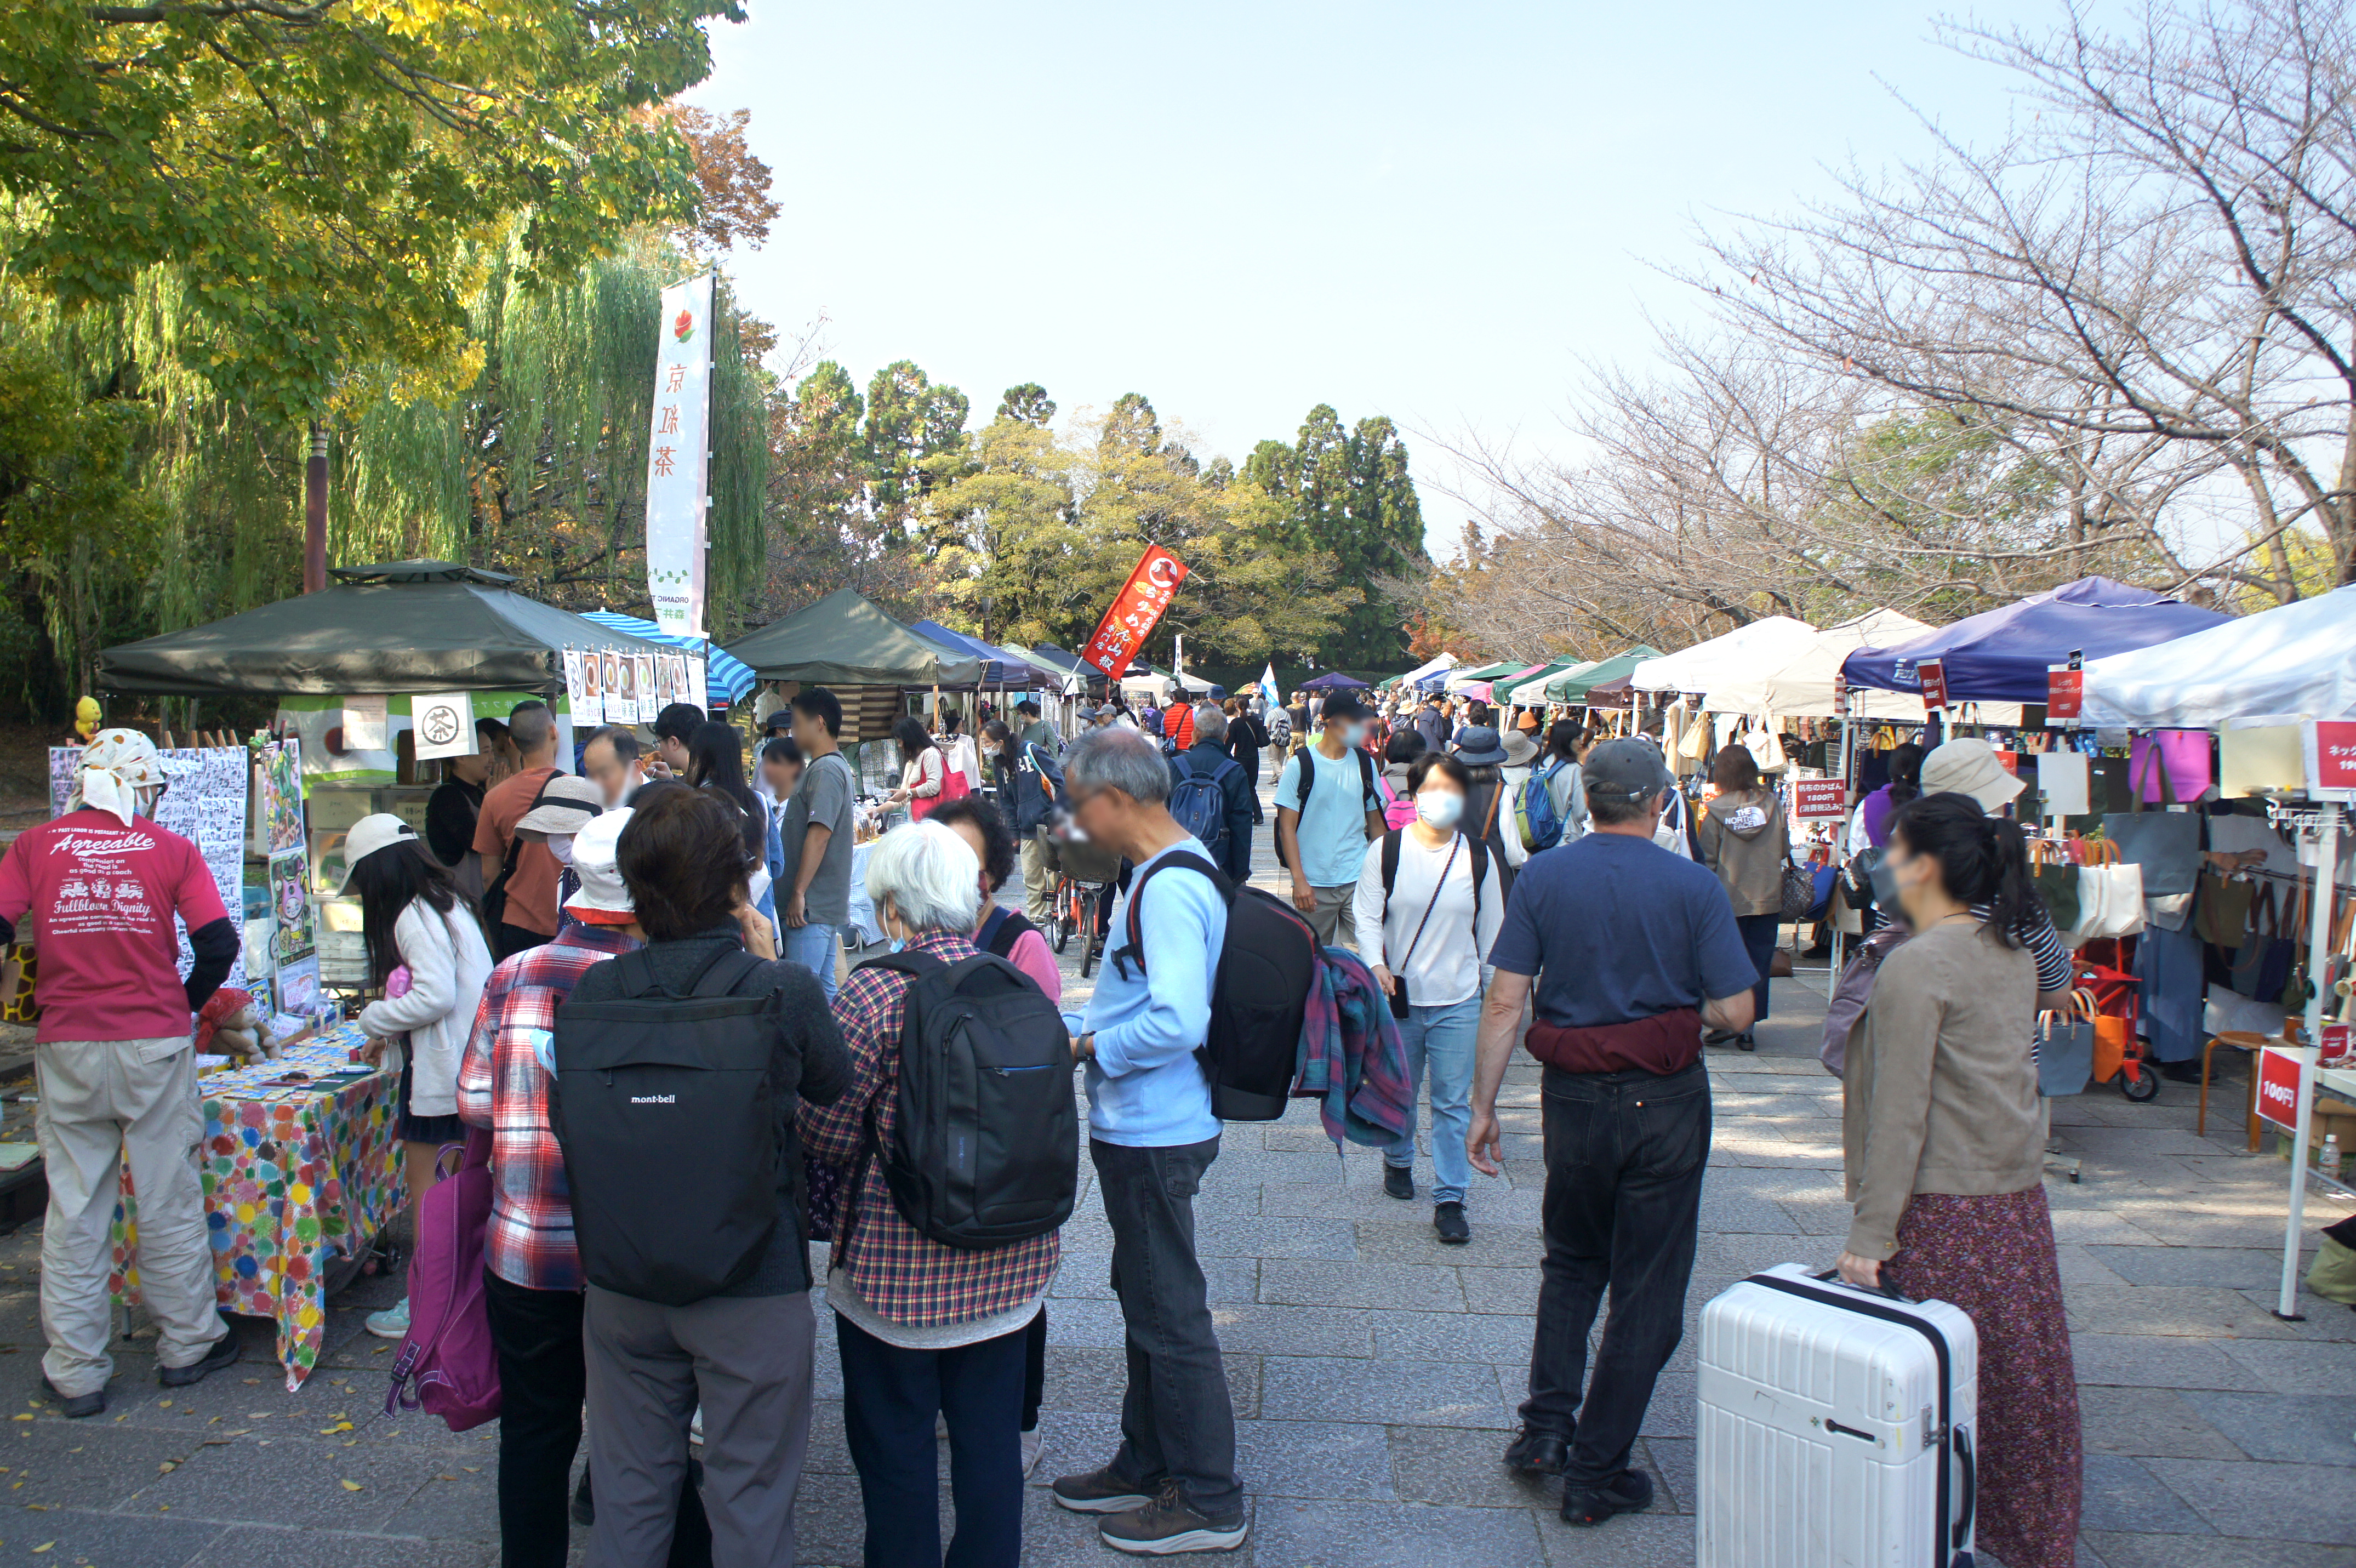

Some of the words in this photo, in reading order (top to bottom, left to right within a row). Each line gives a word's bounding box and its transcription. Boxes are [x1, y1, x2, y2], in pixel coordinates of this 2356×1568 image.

[1099, 586, 1157, 672] ちりめん山椒
[428, 709, 454, 740] 茶
[1798, 783, 1842, 792] 帆布のかばん
[1807, 793, 1835, 801] 1800円
[1736, 807, 1752, 816] THE
[1799, 804, 1842, 813] (消費税込み)
[1725, 816, 1752, 825] NORTH
[1733, 821, 1754, 830] FACE
[50, 832, 155, 857] Agreeable
[54, 899, 110, 914] Fullblown
[111, 899, 151, 917] Dignity
[2263, 1080, 2295, 1108] 100円
